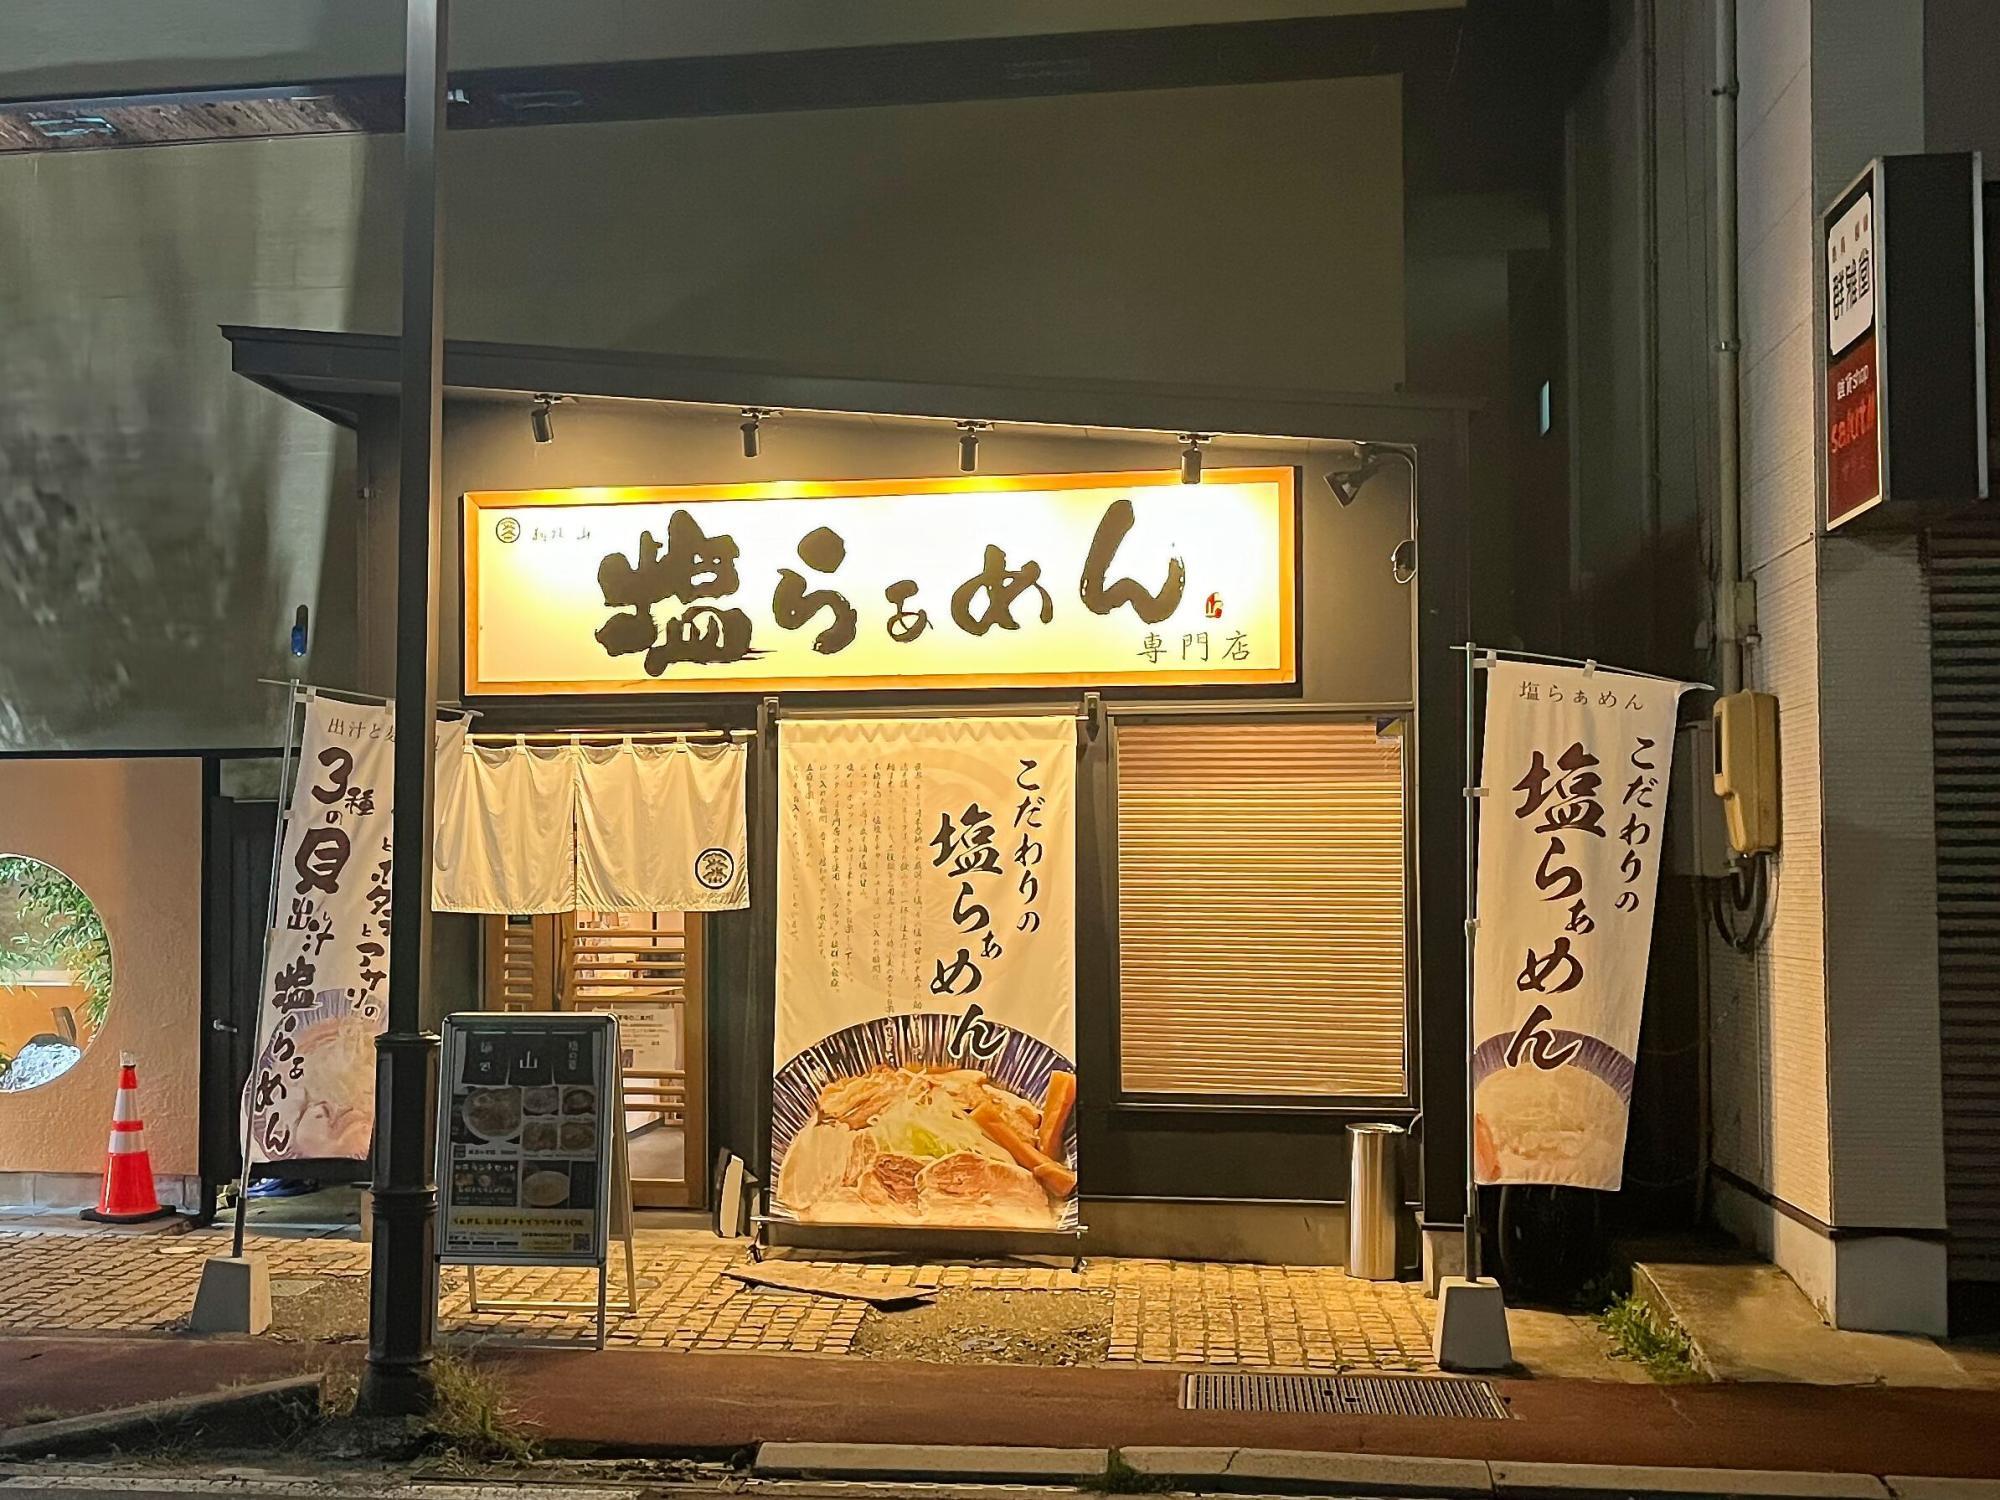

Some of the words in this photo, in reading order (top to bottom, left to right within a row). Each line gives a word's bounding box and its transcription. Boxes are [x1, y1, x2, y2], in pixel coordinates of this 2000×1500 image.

[597, 499, 1186, 677] 塩らぁめん
[1136, 630, 1252, 664] 専門店
[1519, 680, 1645, 712] 塩らぁめん
[1012, 759, 1046, 934] こだわりの
[1506, 741, 1607, 1071] 塩らぁめん
[1614, 736, 1657, 914] こだわりの
[929, 801, 1009, 1061] 塩らぁめん
[519, 1050, 538, 1069] 山
